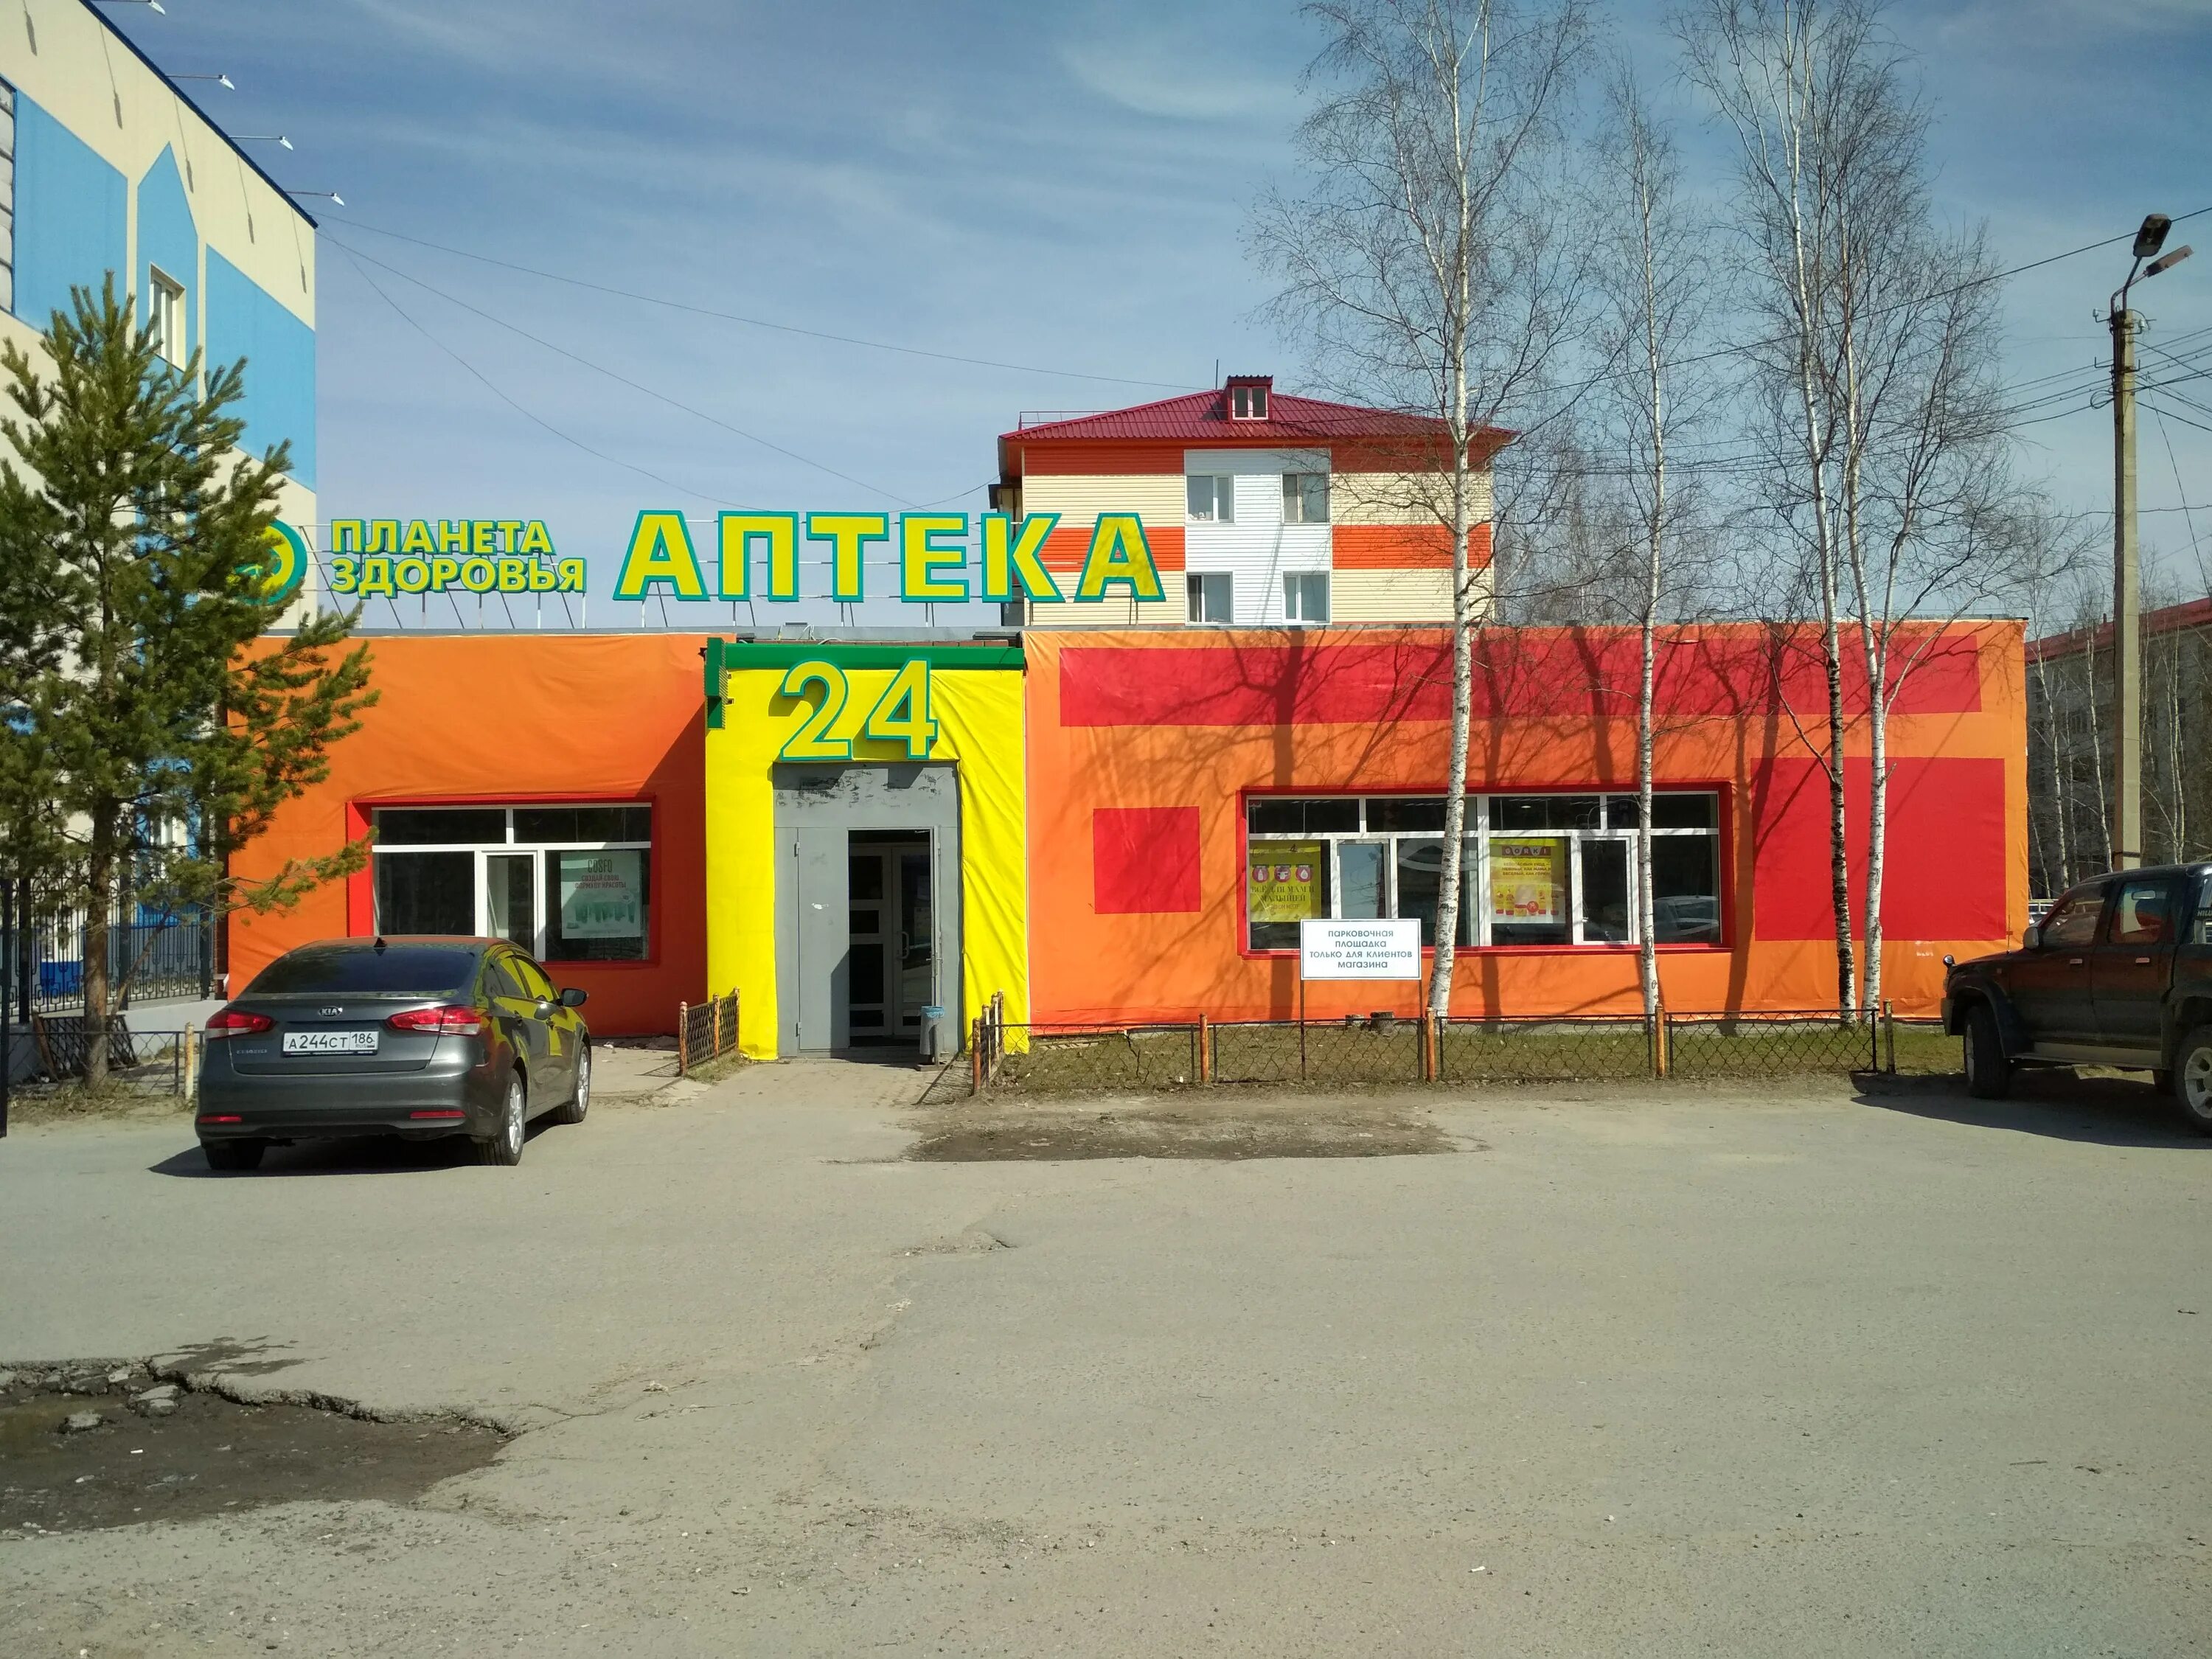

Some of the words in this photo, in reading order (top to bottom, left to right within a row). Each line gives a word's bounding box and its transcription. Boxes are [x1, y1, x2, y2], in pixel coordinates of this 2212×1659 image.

[330, 519, 557, 555] ПЛАНЕТА
[613, 509, 1166, 603] АПТЕКА
[330, 557, 587, 599] ЗДОРОВЬЯ
[780, 658, 939, 761] 24
[1328, 930, 1394, 938] парковочная
[1335, 940, 1387, 948] площадка
[352, 1033, 373, 1044] 186
